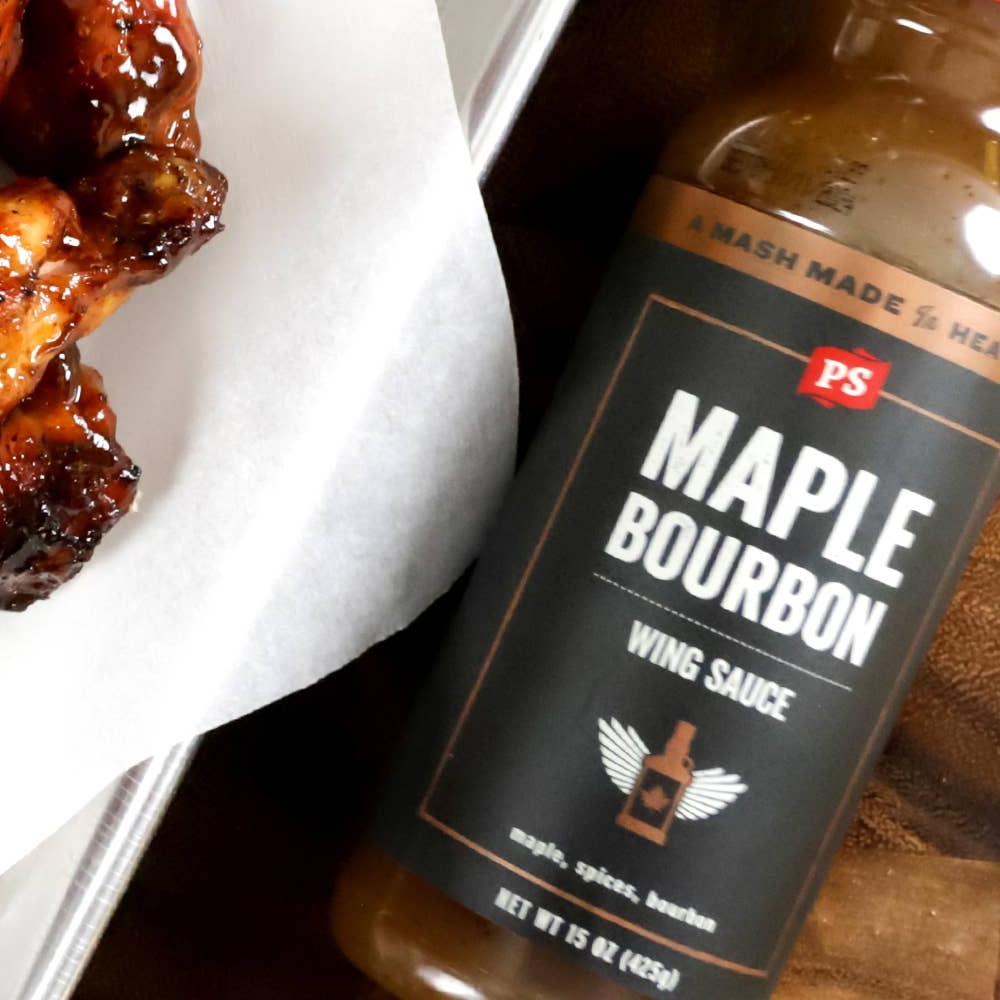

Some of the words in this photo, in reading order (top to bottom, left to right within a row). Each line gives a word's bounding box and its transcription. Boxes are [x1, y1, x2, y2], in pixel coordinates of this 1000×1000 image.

[688, 214, 704, 233] A
[710, 221, 799, 271] MASH
[805, 260, 904, 316] MADE
[814, 358, 874, 397] PS
[640, 389, 936, 588] MAPLE
[604, 491, 888, 667] BOURBON
[627, 620, 705, 682] WING
[704, 658, 797, 722] SAUCE
[509, 826, 569, 869] maple,
[574, 861, 641, 904] spices,
[645, 890, 718, 934] bourbon
[494, 886, 534, 920] NET
[533, 905, 565, 937] WT
[565, 923, 590, 950] 15
[591, 936, 620, 964] OZ
[619, 949, 681, 992] (425g)
